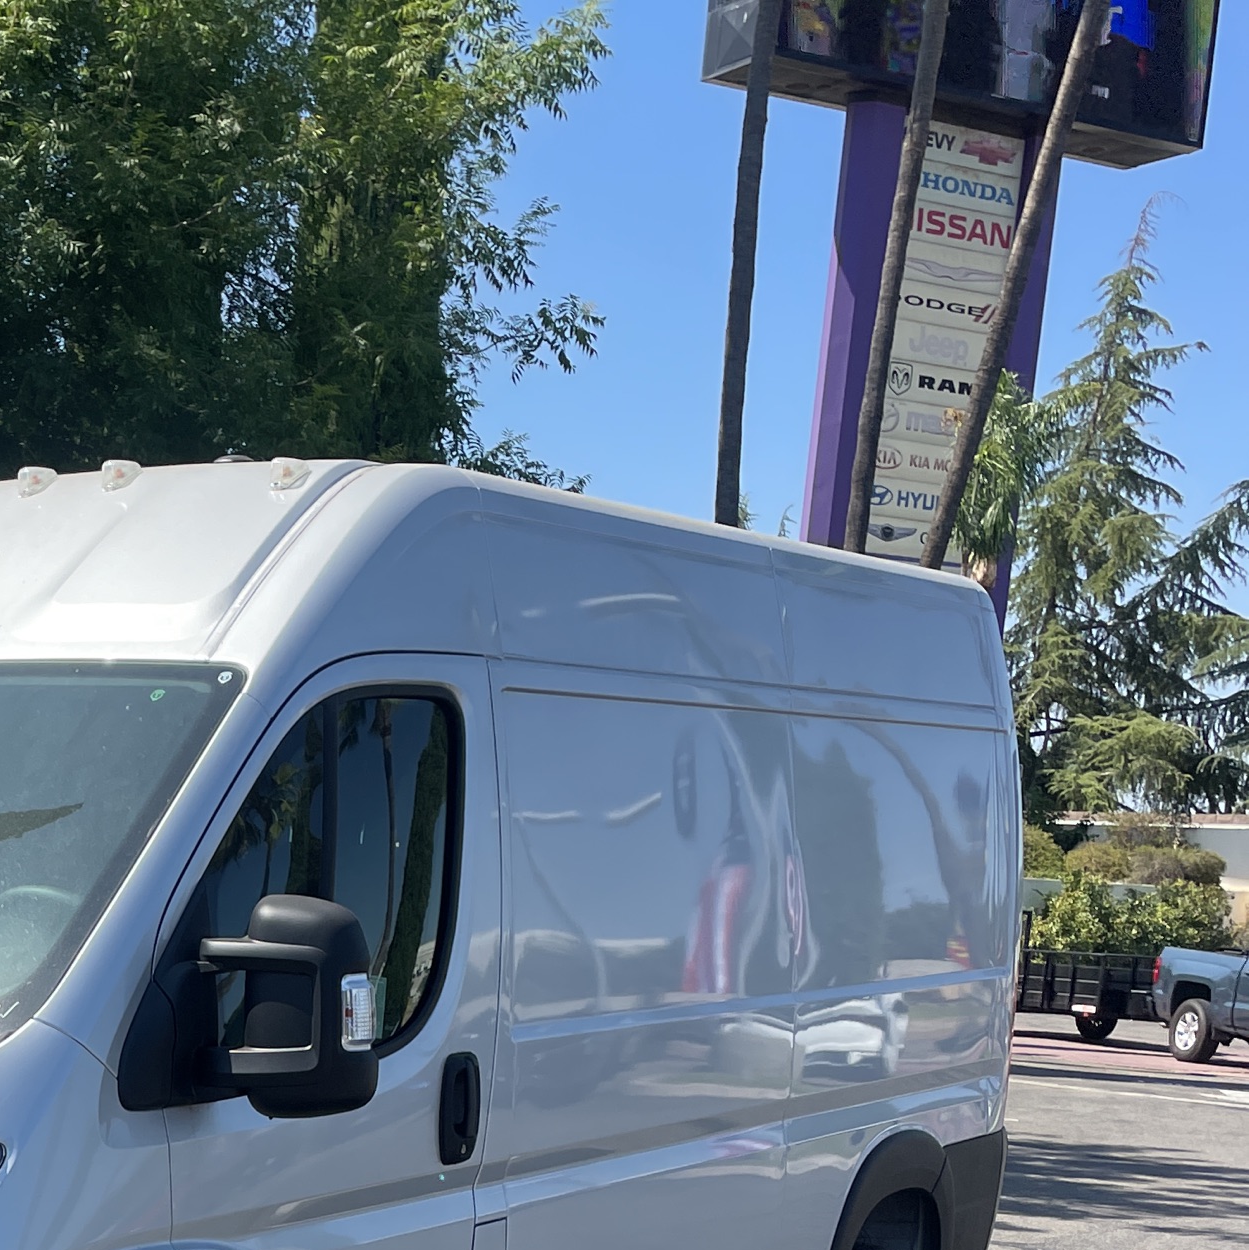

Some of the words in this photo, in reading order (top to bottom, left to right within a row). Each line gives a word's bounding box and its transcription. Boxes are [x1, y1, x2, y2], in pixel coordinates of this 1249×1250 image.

[926, 131, 956, 151] EVY
[921, 171, 1015, 206] HONDA
[913, 207, 1012, 249] ISSAN
[898, 294, 984, 318] ODGE
[908, 325, 969, 365] Jeep
[909, 454, 930, 470] KIA
